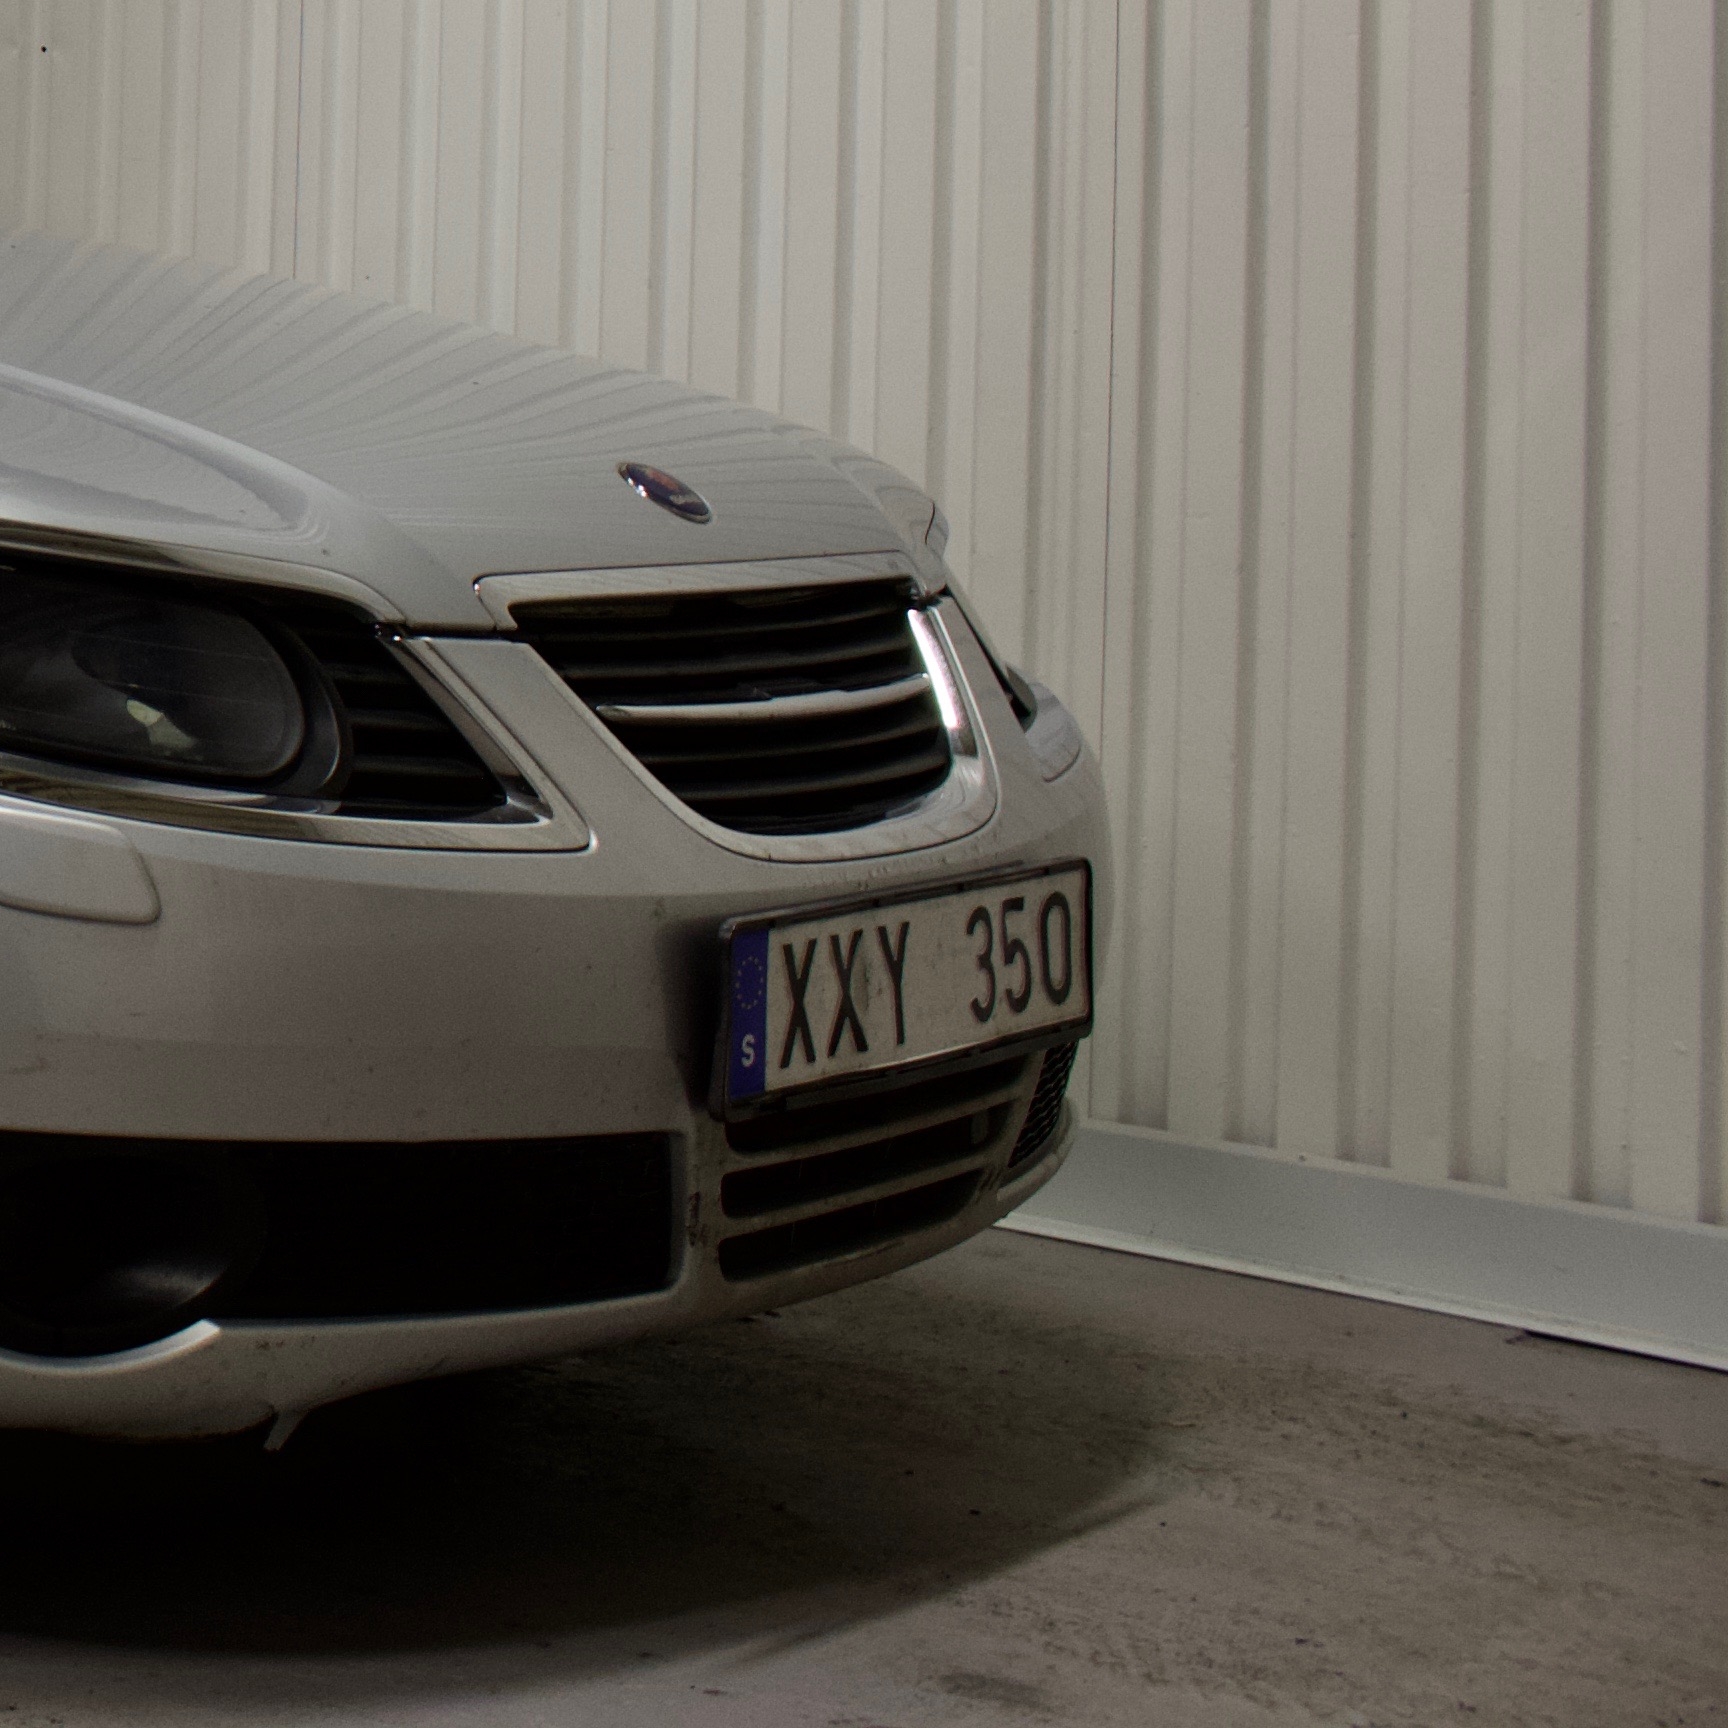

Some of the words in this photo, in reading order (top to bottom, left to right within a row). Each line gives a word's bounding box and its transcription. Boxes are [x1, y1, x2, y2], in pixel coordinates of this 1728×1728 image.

[777, 920, 912, 1071] XXY
[964, 889, 1075, 1026] 350
[740, 1033, 756, 1069] S
